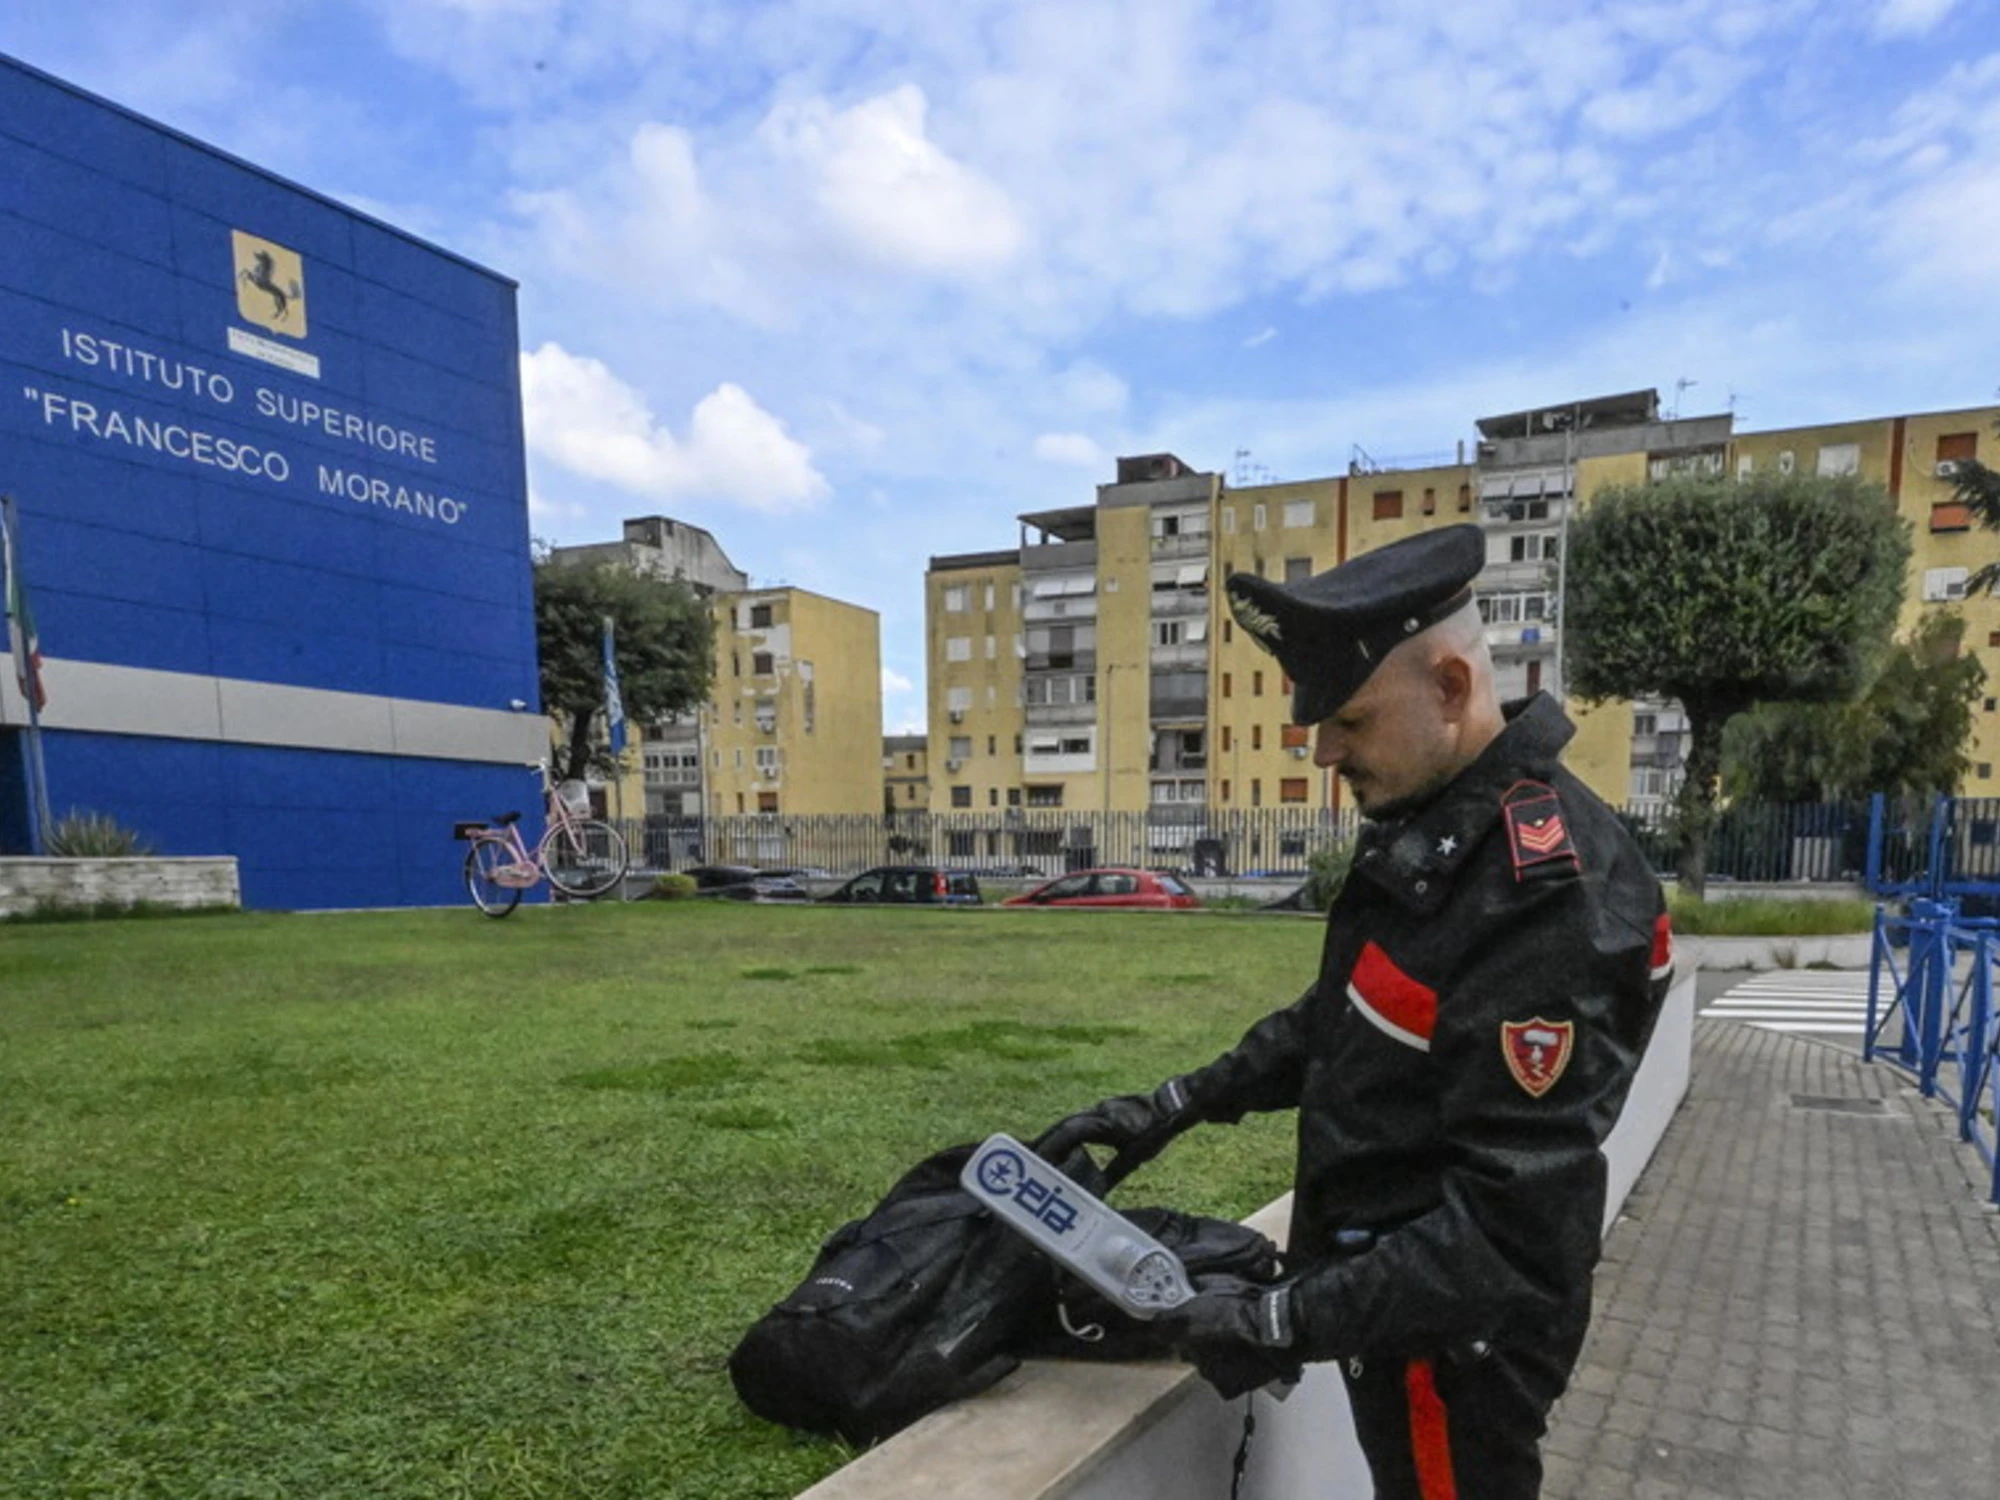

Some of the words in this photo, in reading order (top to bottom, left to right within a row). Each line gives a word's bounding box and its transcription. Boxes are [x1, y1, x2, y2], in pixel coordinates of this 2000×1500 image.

[24, 387, 289, 482] "FRANCESCO
[319, 465, 467, 525] MORANO"
[62, 328, 233, 403] ISTITUTO
[256, 388, 437, 463] SUPERIORE
